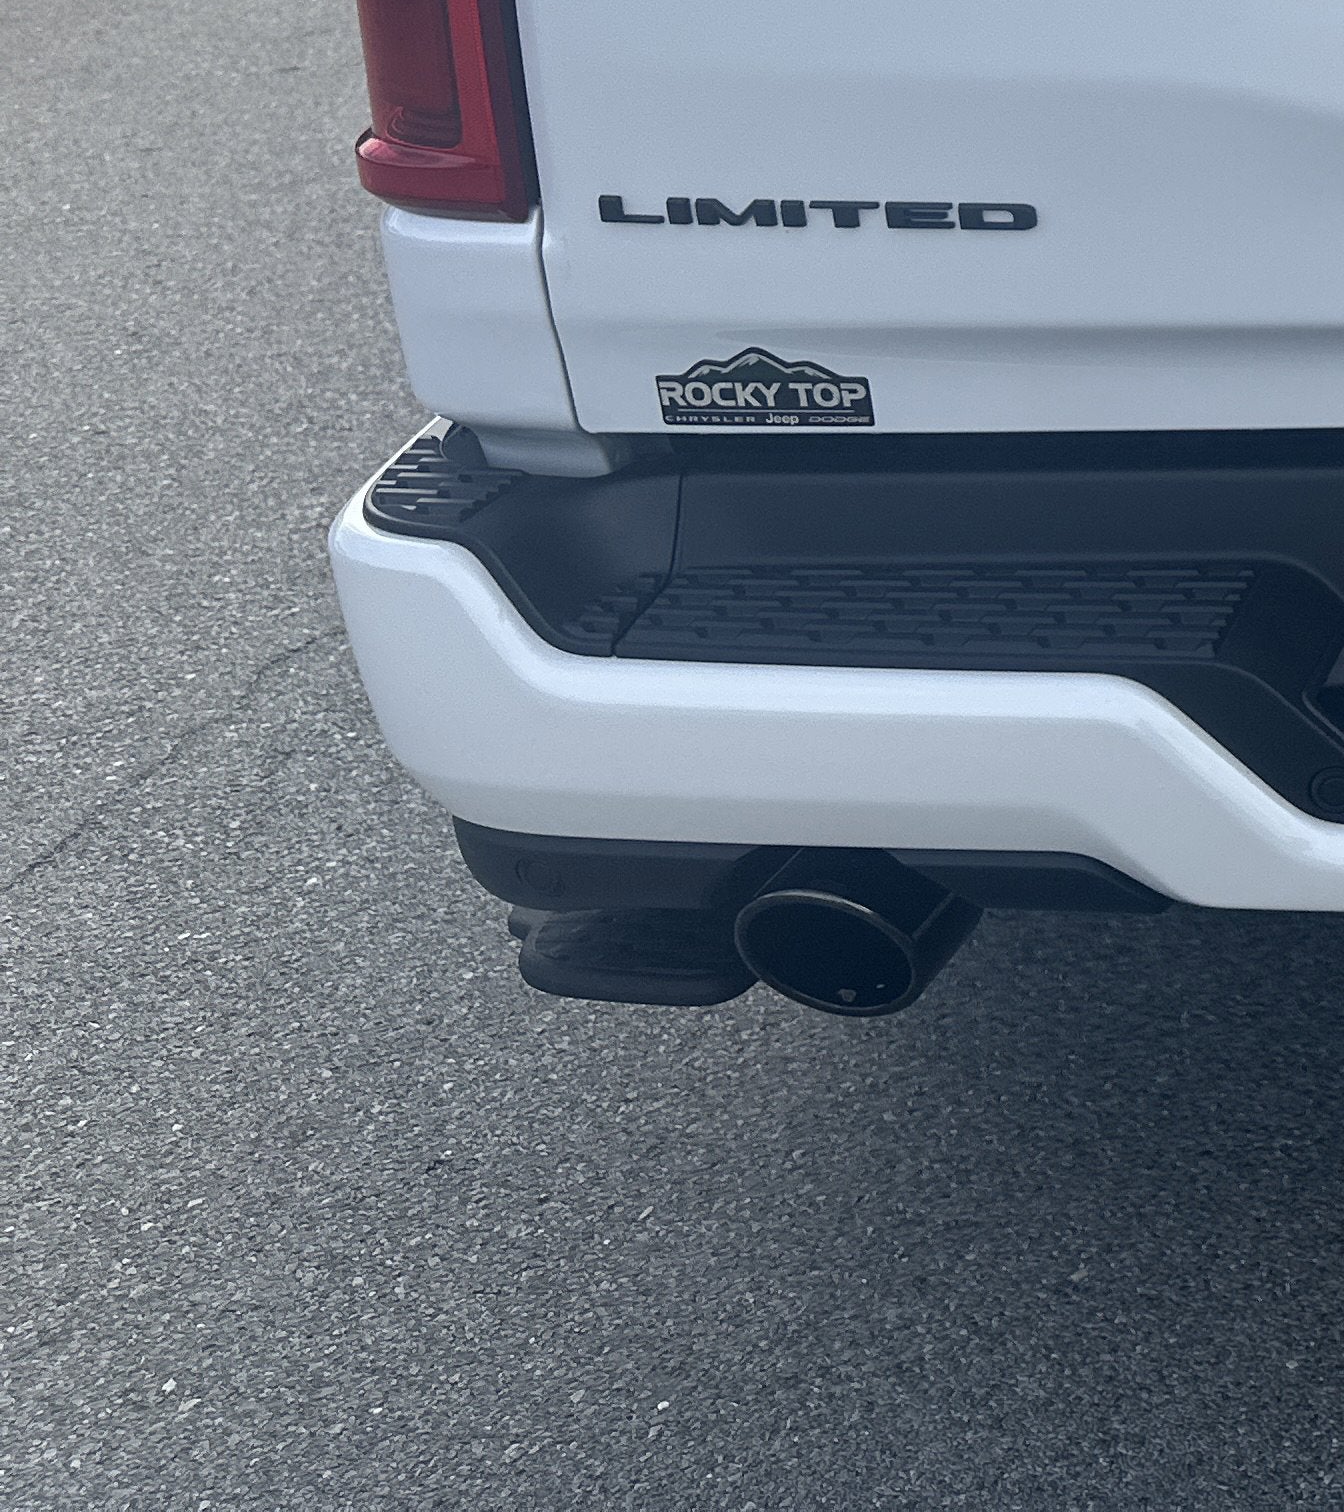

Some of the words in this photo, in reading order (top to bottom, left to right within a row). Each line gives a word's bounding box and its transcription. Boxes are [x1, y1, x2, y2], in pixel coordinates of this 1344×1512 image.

[598, 194, 1038, 231] LIMITED
[658, 381, 781, 408] ROCKY
[789, 382, 867, 408] TOP
[665, 415, 756, 423] CHRYSLER
[765, 413, 799, 425] Jeep
